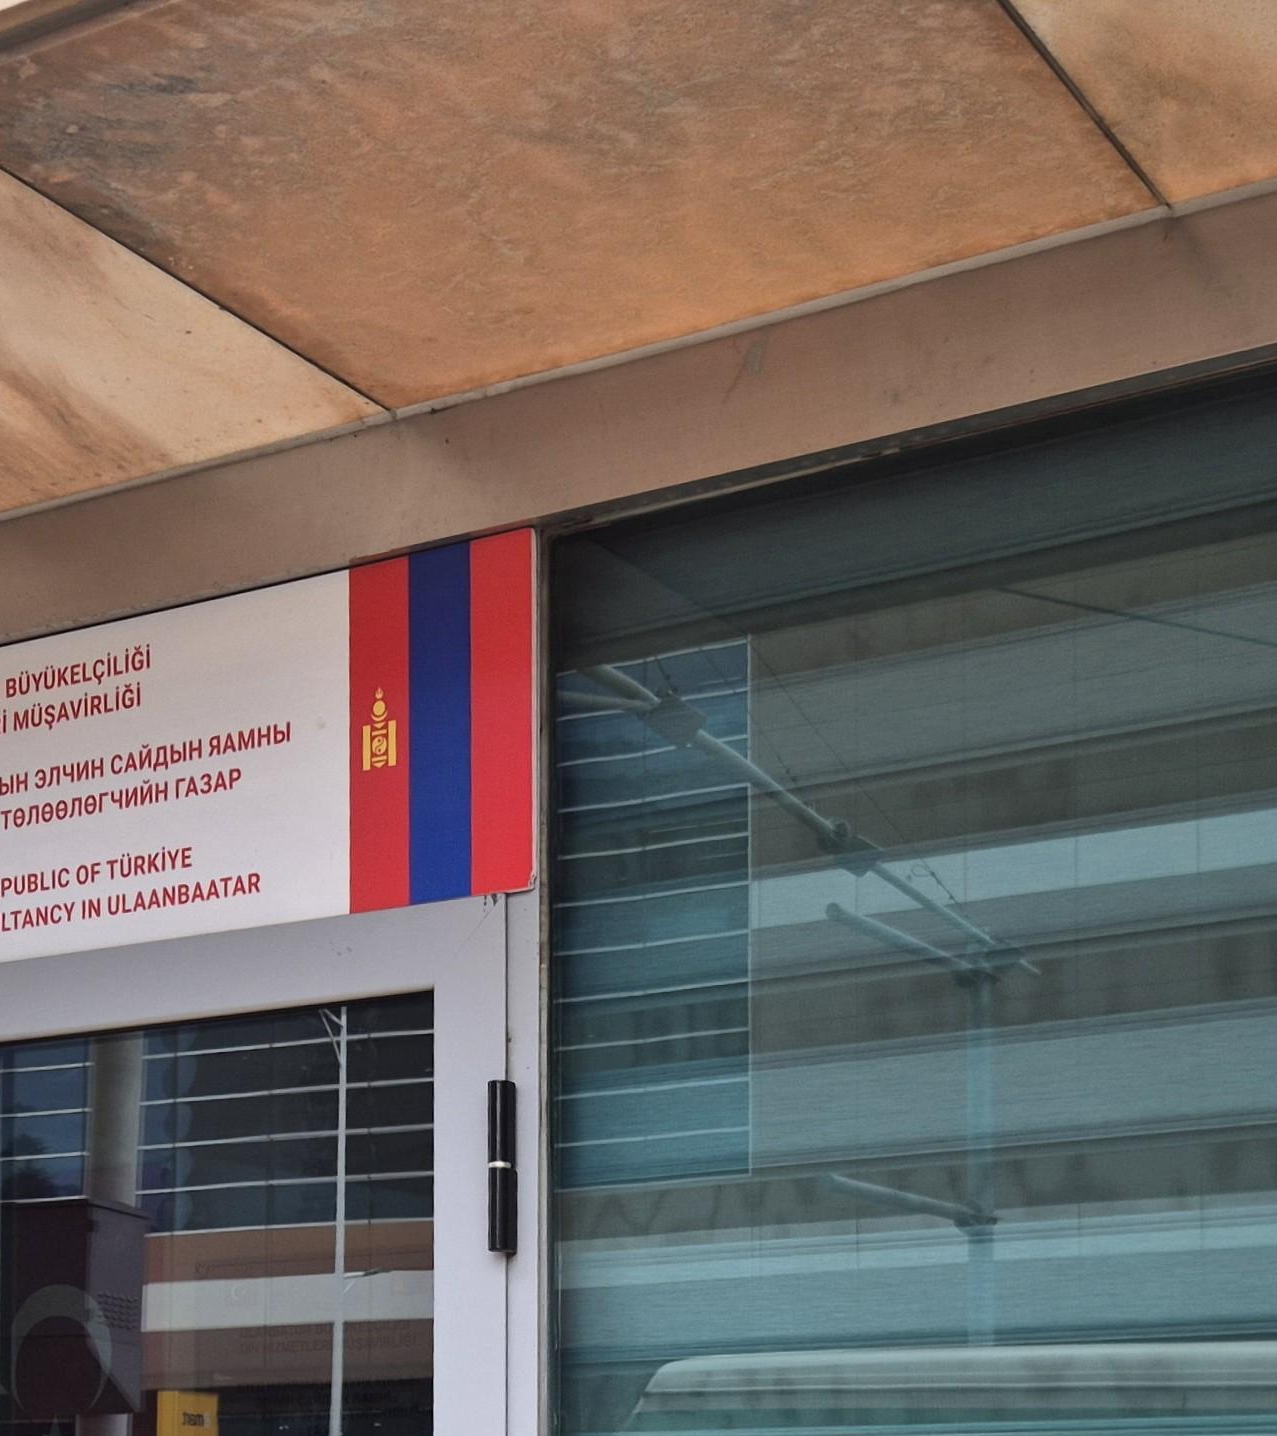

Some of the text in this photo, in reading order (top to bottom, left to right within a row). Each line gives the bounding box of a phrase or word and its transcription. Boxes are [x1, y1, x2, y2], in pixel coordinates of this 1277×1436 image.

[6, 644, 151, 697] BÜYÜKELÇİLİĞİ
[13, 682, 141, 732] MÜŞAVİRLİĞİ
[34, 758, 104, 789] ЭЛЧИН
[111, 738, 202, 774] САЙДЫН
[209, 721, 291, 757] ЯАМНЫ
[0, 780, 168, 831] ТӨЛӨӨЛӨГЧИЙН
[176, 768, 242, 799] ГАЗАР
[76, 862, 101, 885] OF
[106, 846, 193, 880] TÜRKİYE
[82, 897, 101, 920] IN
[107, 872, 260, 915] ULAANBAATAR
